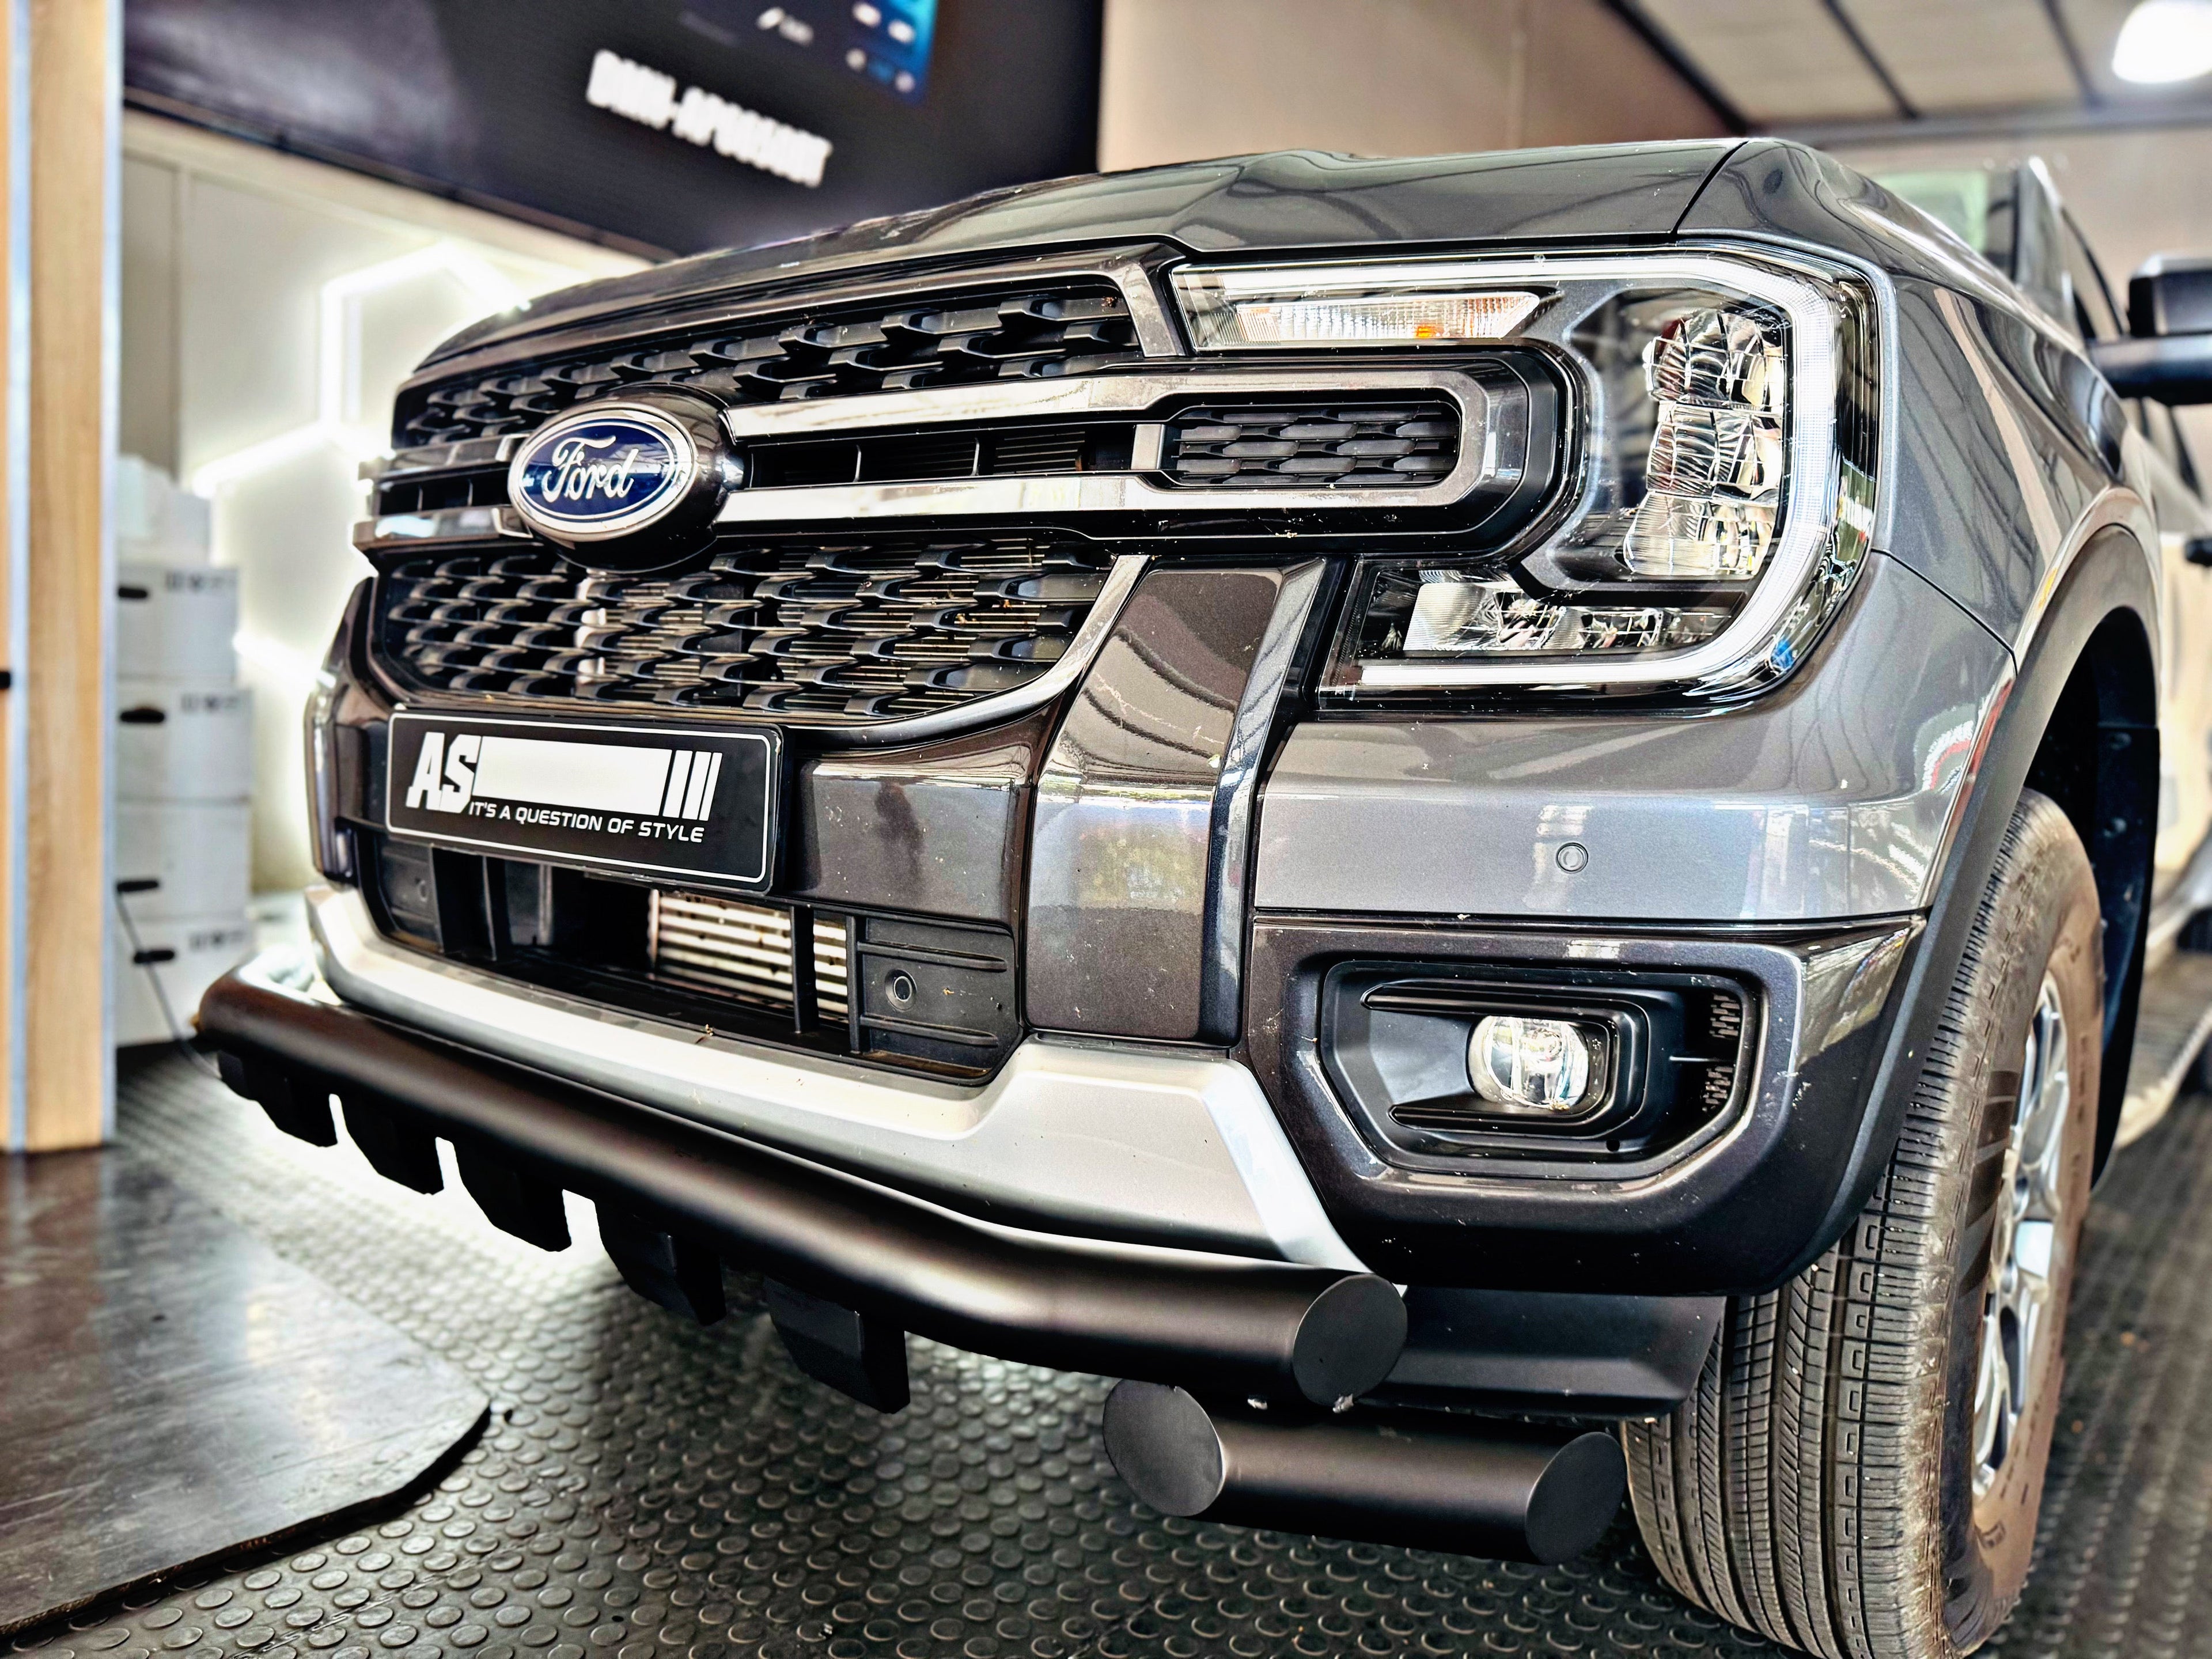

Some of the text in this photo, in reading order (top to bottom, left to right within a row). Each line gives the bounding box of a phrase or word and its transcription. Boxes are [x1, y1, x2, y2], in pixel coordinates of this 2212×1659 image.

[542, 435, 639, 503] Ford
[468, 801, 705, 843] IT'S A QUESTION OF STYLE
